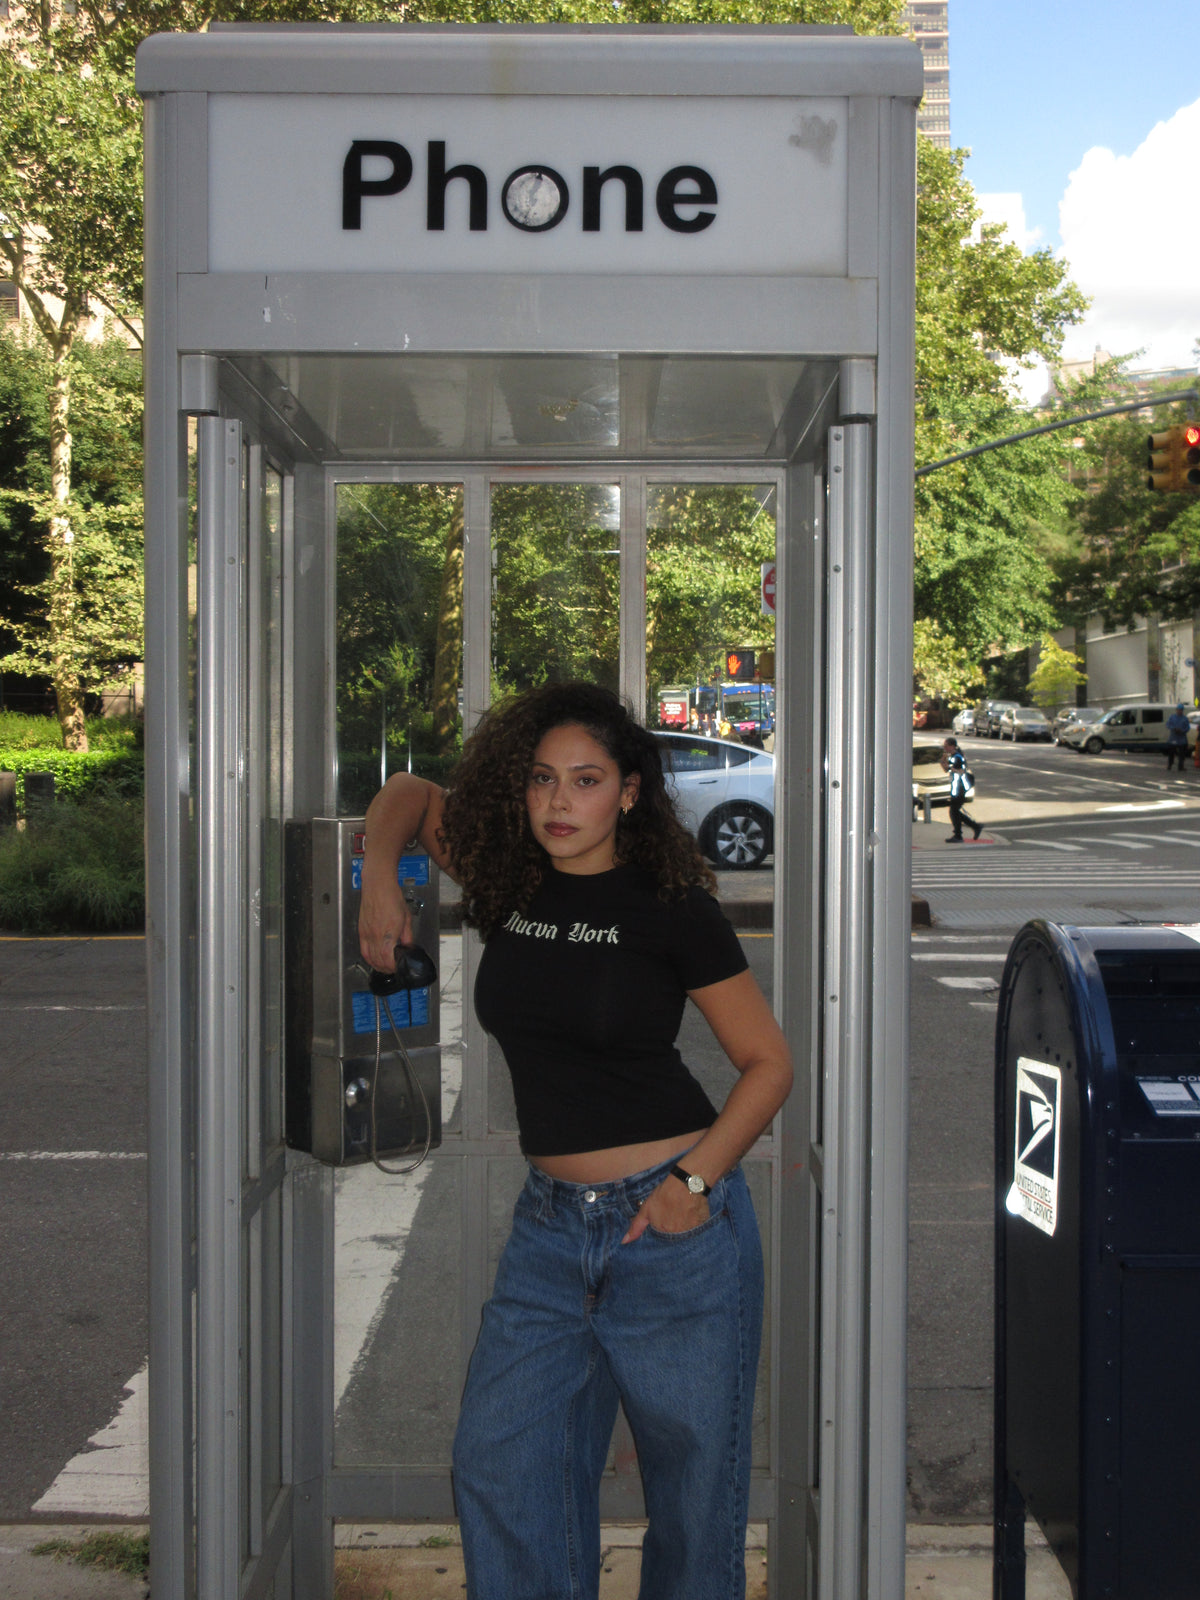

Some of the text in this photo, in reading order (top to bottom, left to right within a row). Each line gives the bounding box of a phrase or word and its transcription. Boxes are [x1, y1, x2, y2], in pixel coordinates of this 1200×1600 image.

[342, 140, 718, 233] Phone
[503, 910, 619, 944] Nueva York
[1016, 1172, 1052, 1204] UNITED STATES
[1033, 1200, 1053, 1224] SERVICE
